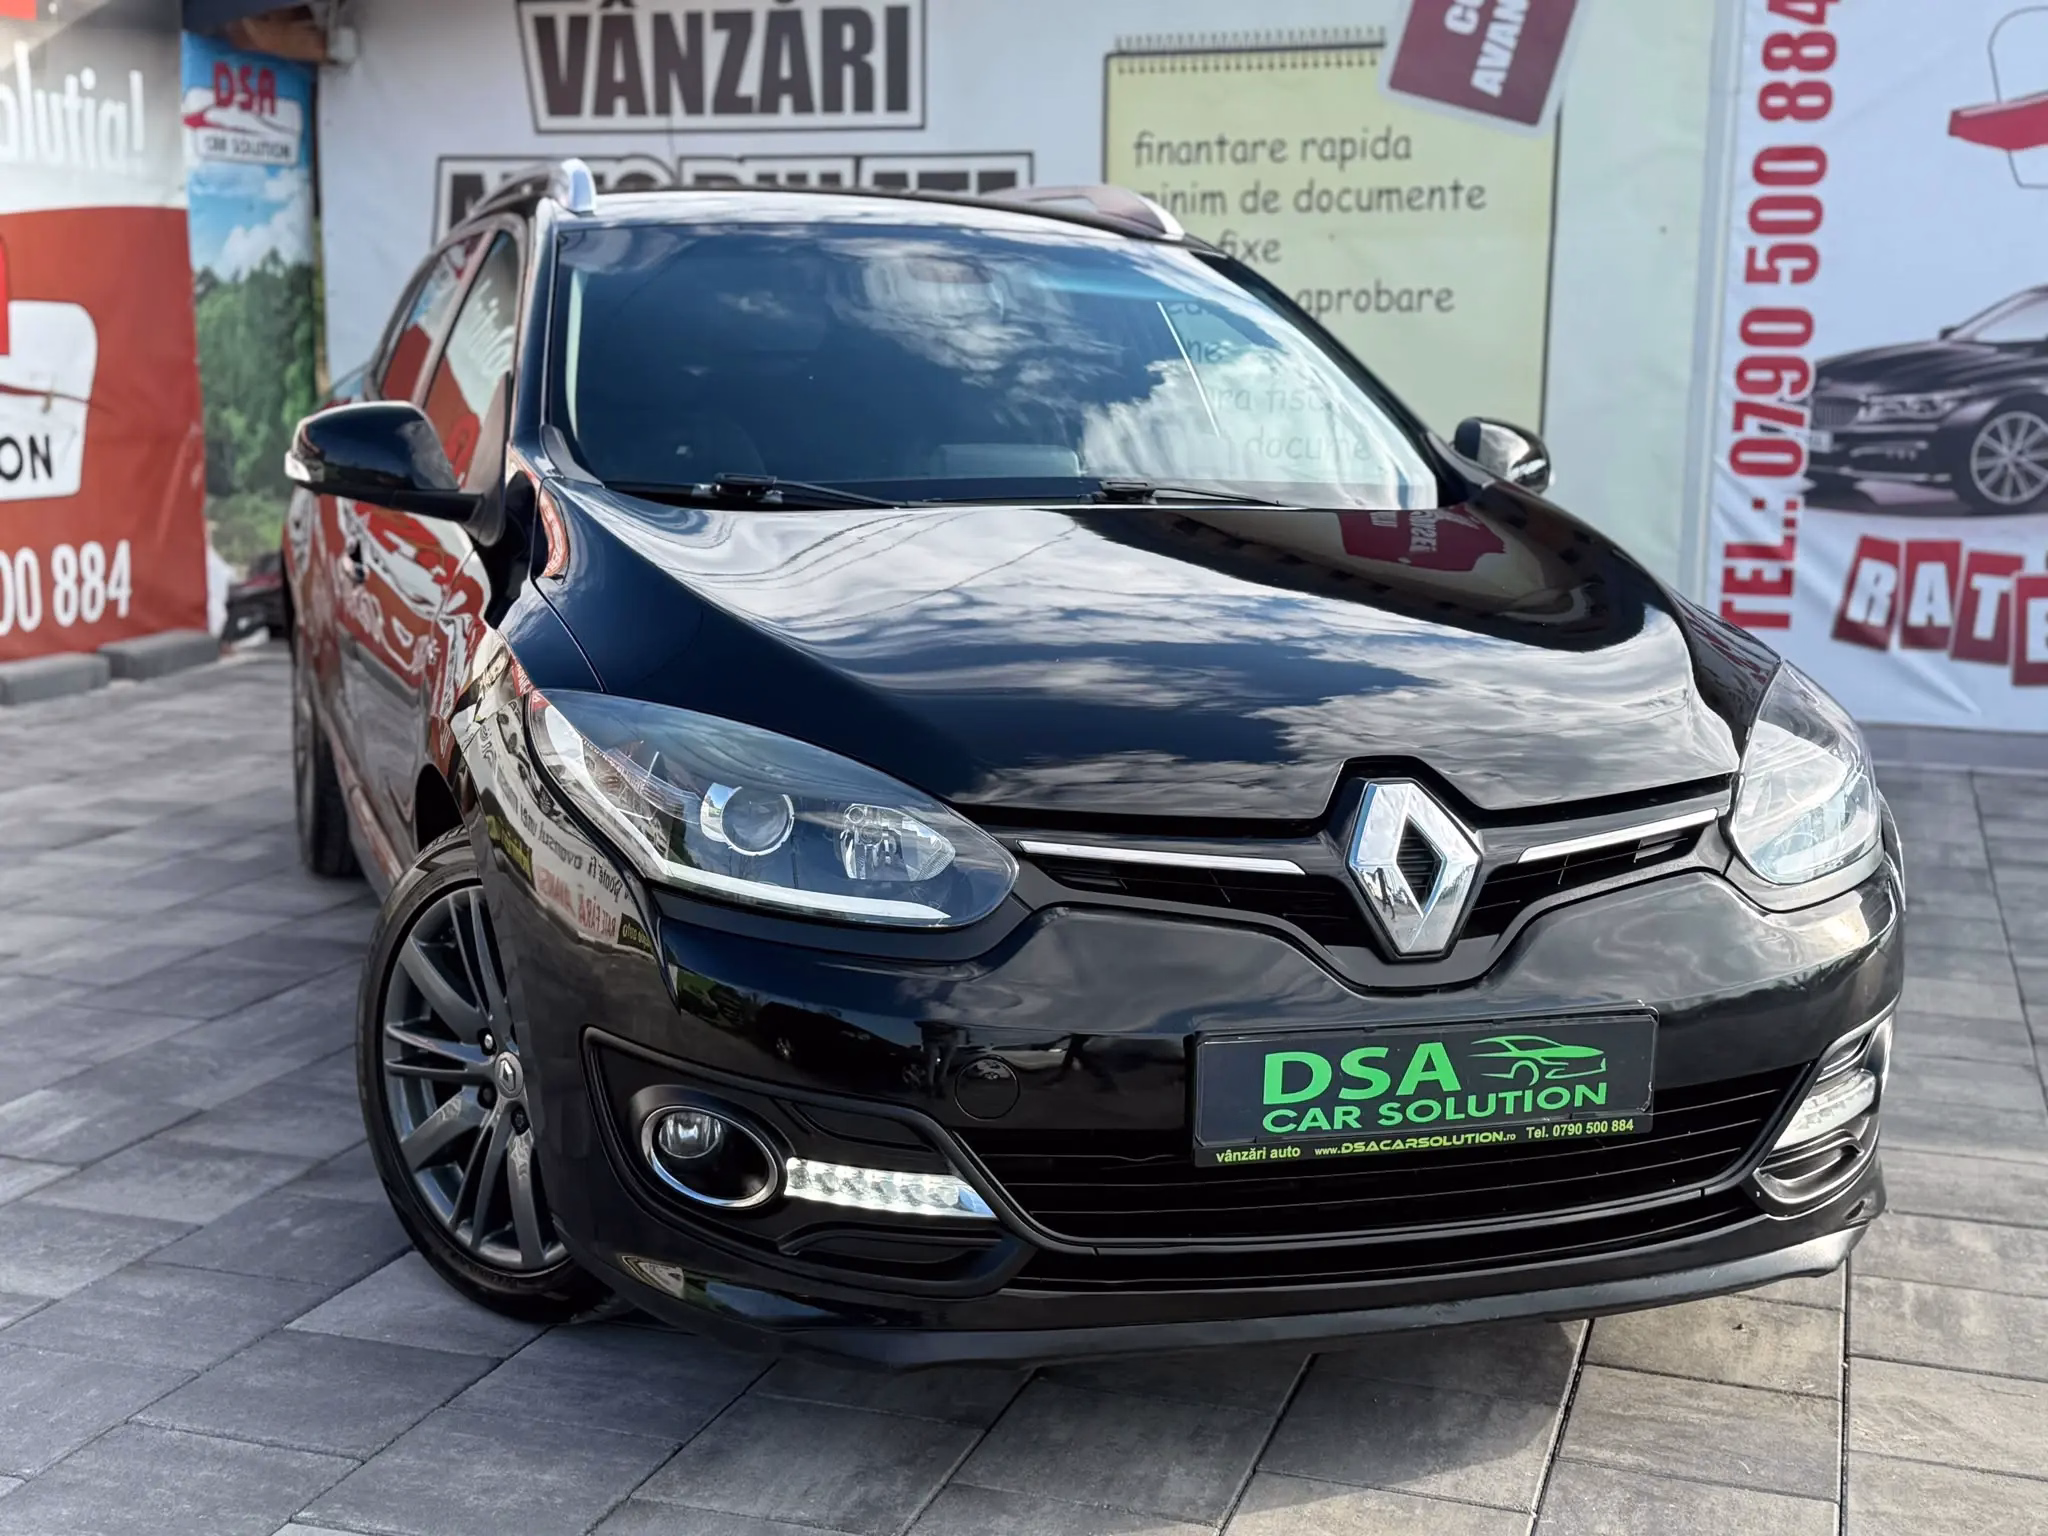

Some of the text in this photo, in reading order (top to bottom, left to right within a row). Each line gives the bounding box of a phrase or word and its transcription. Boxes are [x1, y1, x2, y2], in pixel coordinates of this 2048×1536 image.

[213, 60, 277, 117] DSA
[1134, 125, 1413, 172] finantare rapida
[1240, 178, 1282, 215] de
[1292, 177, 1488, 214] documente
[1745, 145, 1828, 285] 500
[1728, 306, 1815, 479] 0790
[52, 539, 132, 628] 884
[1263, 1041, 1461, 1105] DSA
[1262, 1082, 1606, 1134] CAR SOLUTION
[1216, 1145, 1267, 1163] vânzări
[1270, 1145, 1301, 1160] auto
[1526, 1125, 1549, 1140] Tel.
[1552, 1122, 1582, 1138] 0790
[1586, 1120, 1608, 1135] 500
[1611, 1118, 1634, 1133] 884
